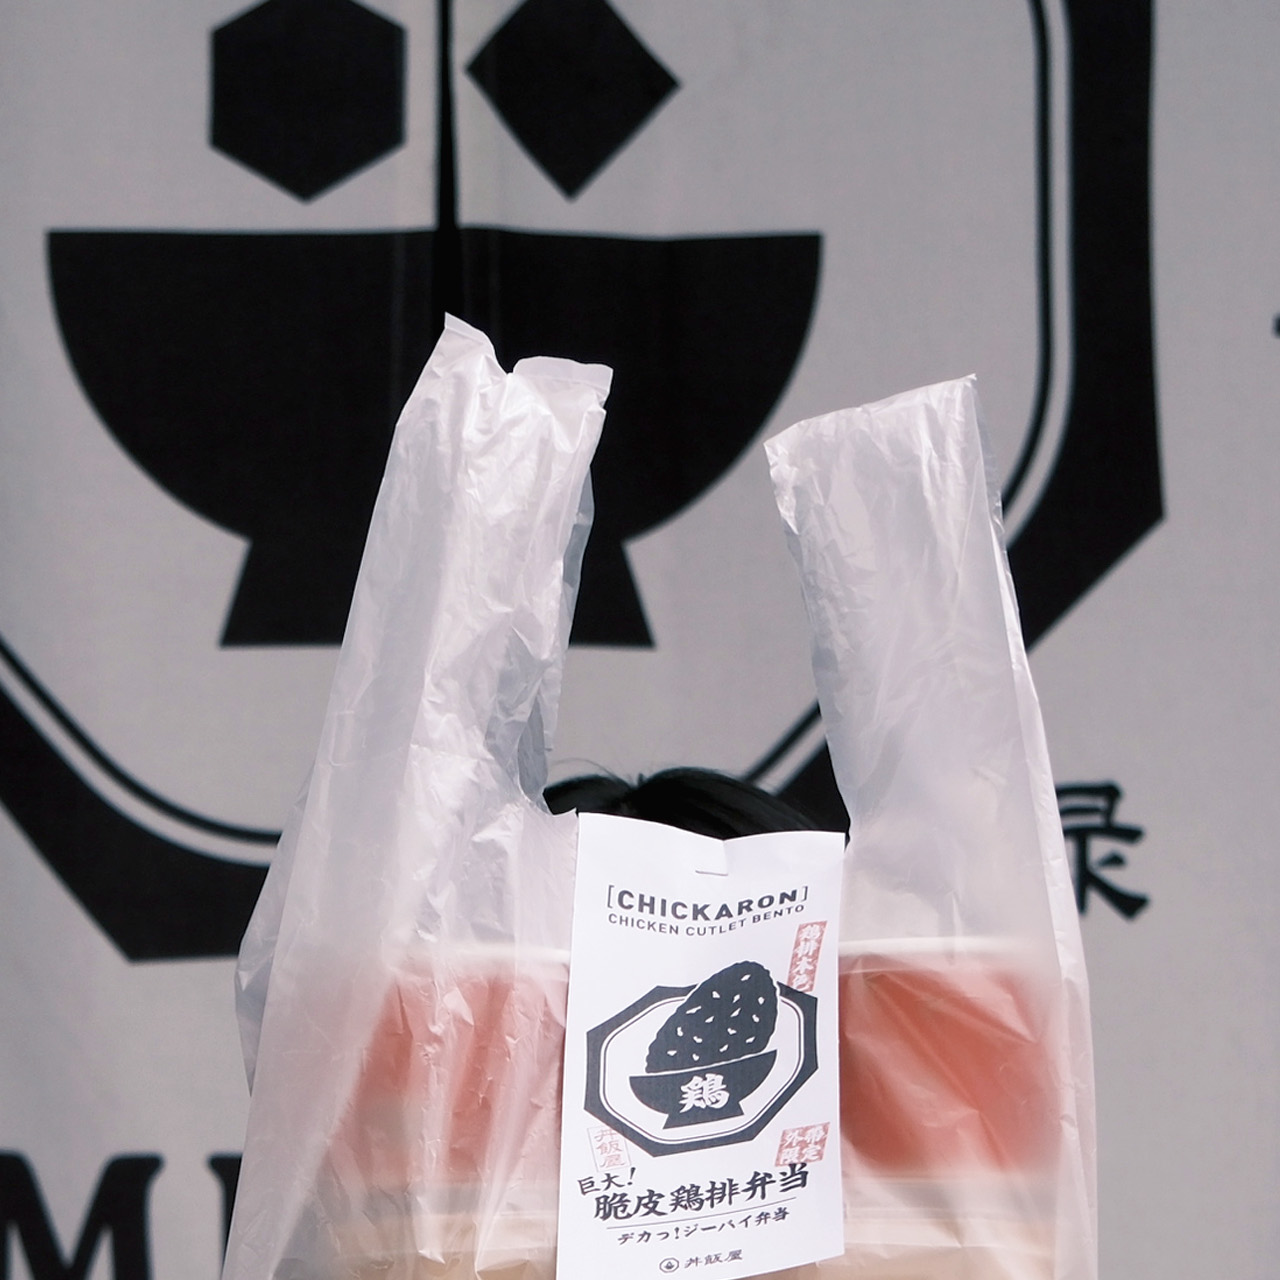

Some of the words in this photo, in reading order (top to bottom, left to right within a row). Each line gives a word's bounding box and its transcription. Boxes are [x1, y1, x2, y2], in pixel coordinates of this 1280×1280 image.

[608, 913, 679, 935] CHICKEN
[685, 918, 747, 937] CUTLET
[752, 904, 805, 924] BENTO
